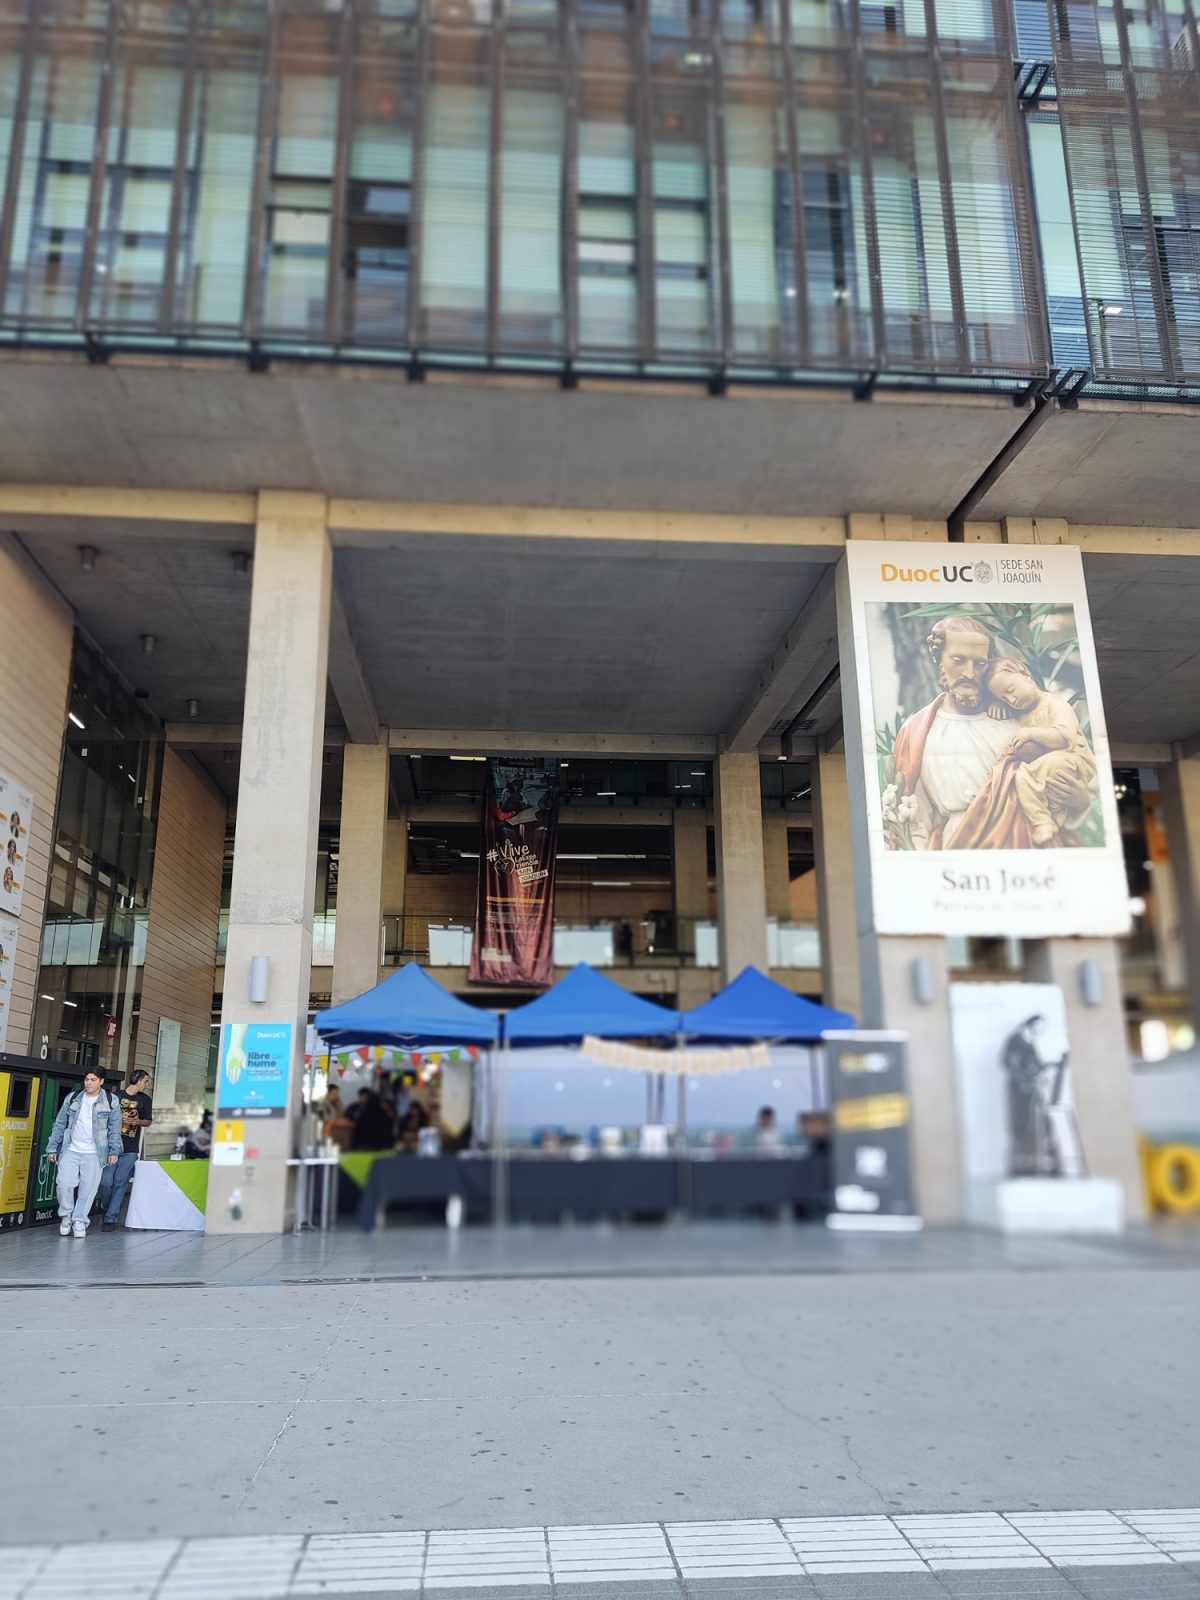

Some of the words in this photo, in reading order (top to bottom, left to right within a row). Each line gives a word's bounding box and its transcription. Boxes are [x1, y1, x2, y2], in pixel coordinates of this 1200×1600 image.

[1000, 559, 1023, 570] SEDE
[1025, 559, 1044, 570] SAN
[1002, 571, 1042, 584] JOAQUÍN
[486, 844, 530, 862] #Vive
[942, 868, 991, 891] San
[1000, 865, 1056, 894] José
[247, 1050, 270, 1060] libro
[247, 1059, 277, 1068] humo
